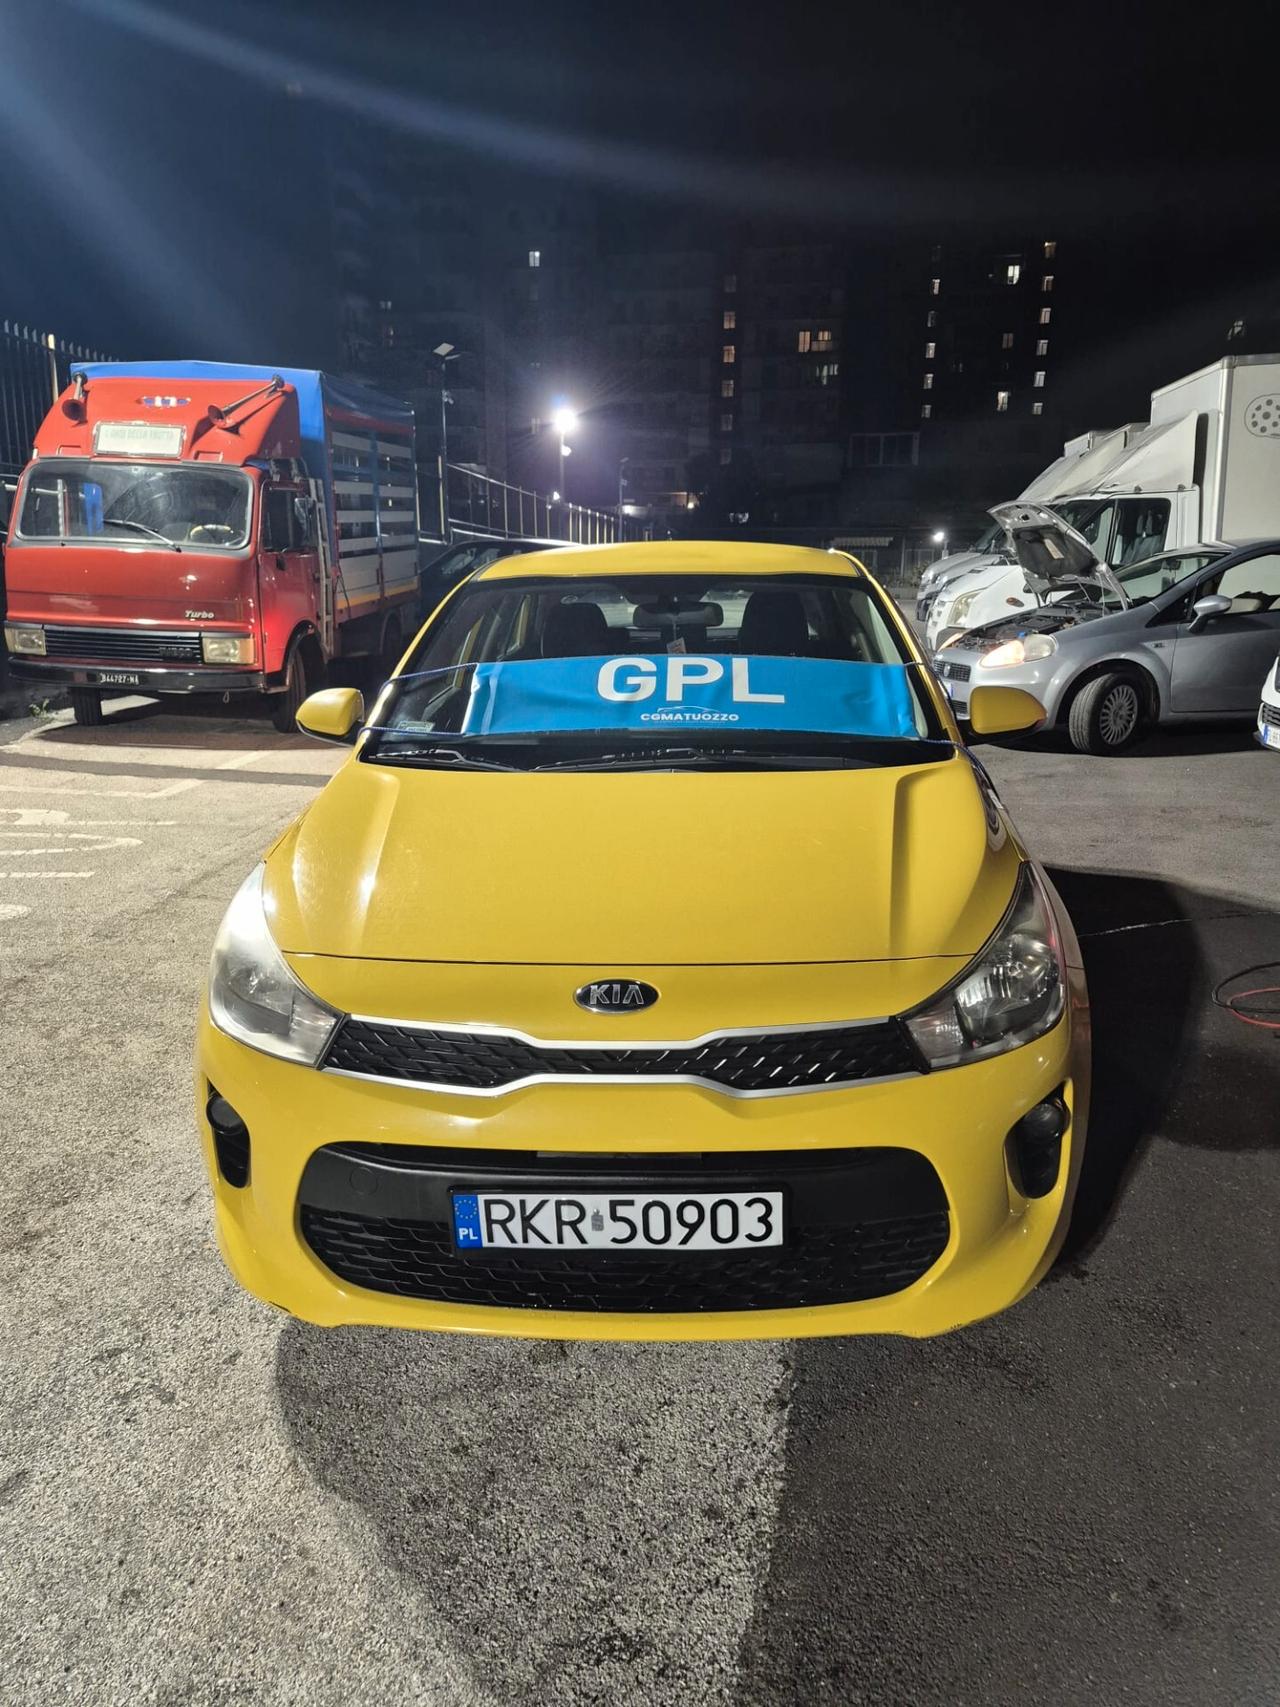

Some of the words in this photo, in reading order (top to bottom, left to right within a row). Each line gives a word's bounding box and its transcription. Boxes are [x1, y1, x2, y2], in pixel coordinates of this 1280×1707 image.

[185, 609, 215, 619] Turbo
[597, 656, 785, 704] GPL
[590, 984, 644, 1004] KIA
[483, 1199, 588, 1245] RKR
[609, 1197, 773, 1246] 50903
[458, 1227, 478, 1241] PL
